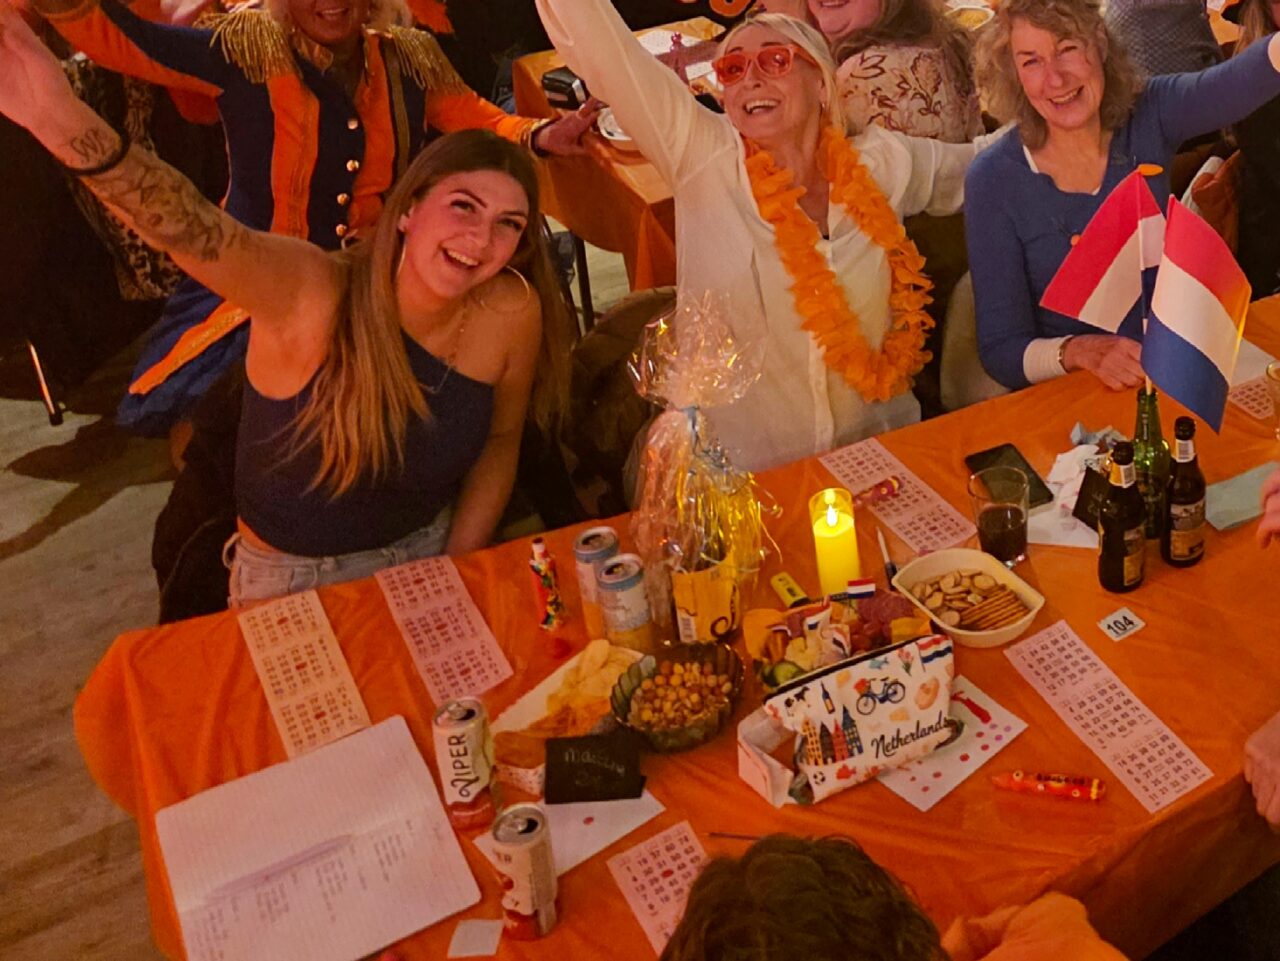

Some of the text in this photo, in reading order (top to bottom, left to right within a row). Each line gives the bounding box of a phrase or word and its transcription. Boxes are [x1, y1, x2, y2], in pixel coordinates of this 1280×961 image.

[1106, 615, 1135, 636] 104
[870, 710, 952, 760] Netherlands
[447, 733, 480, 798] VIPER
